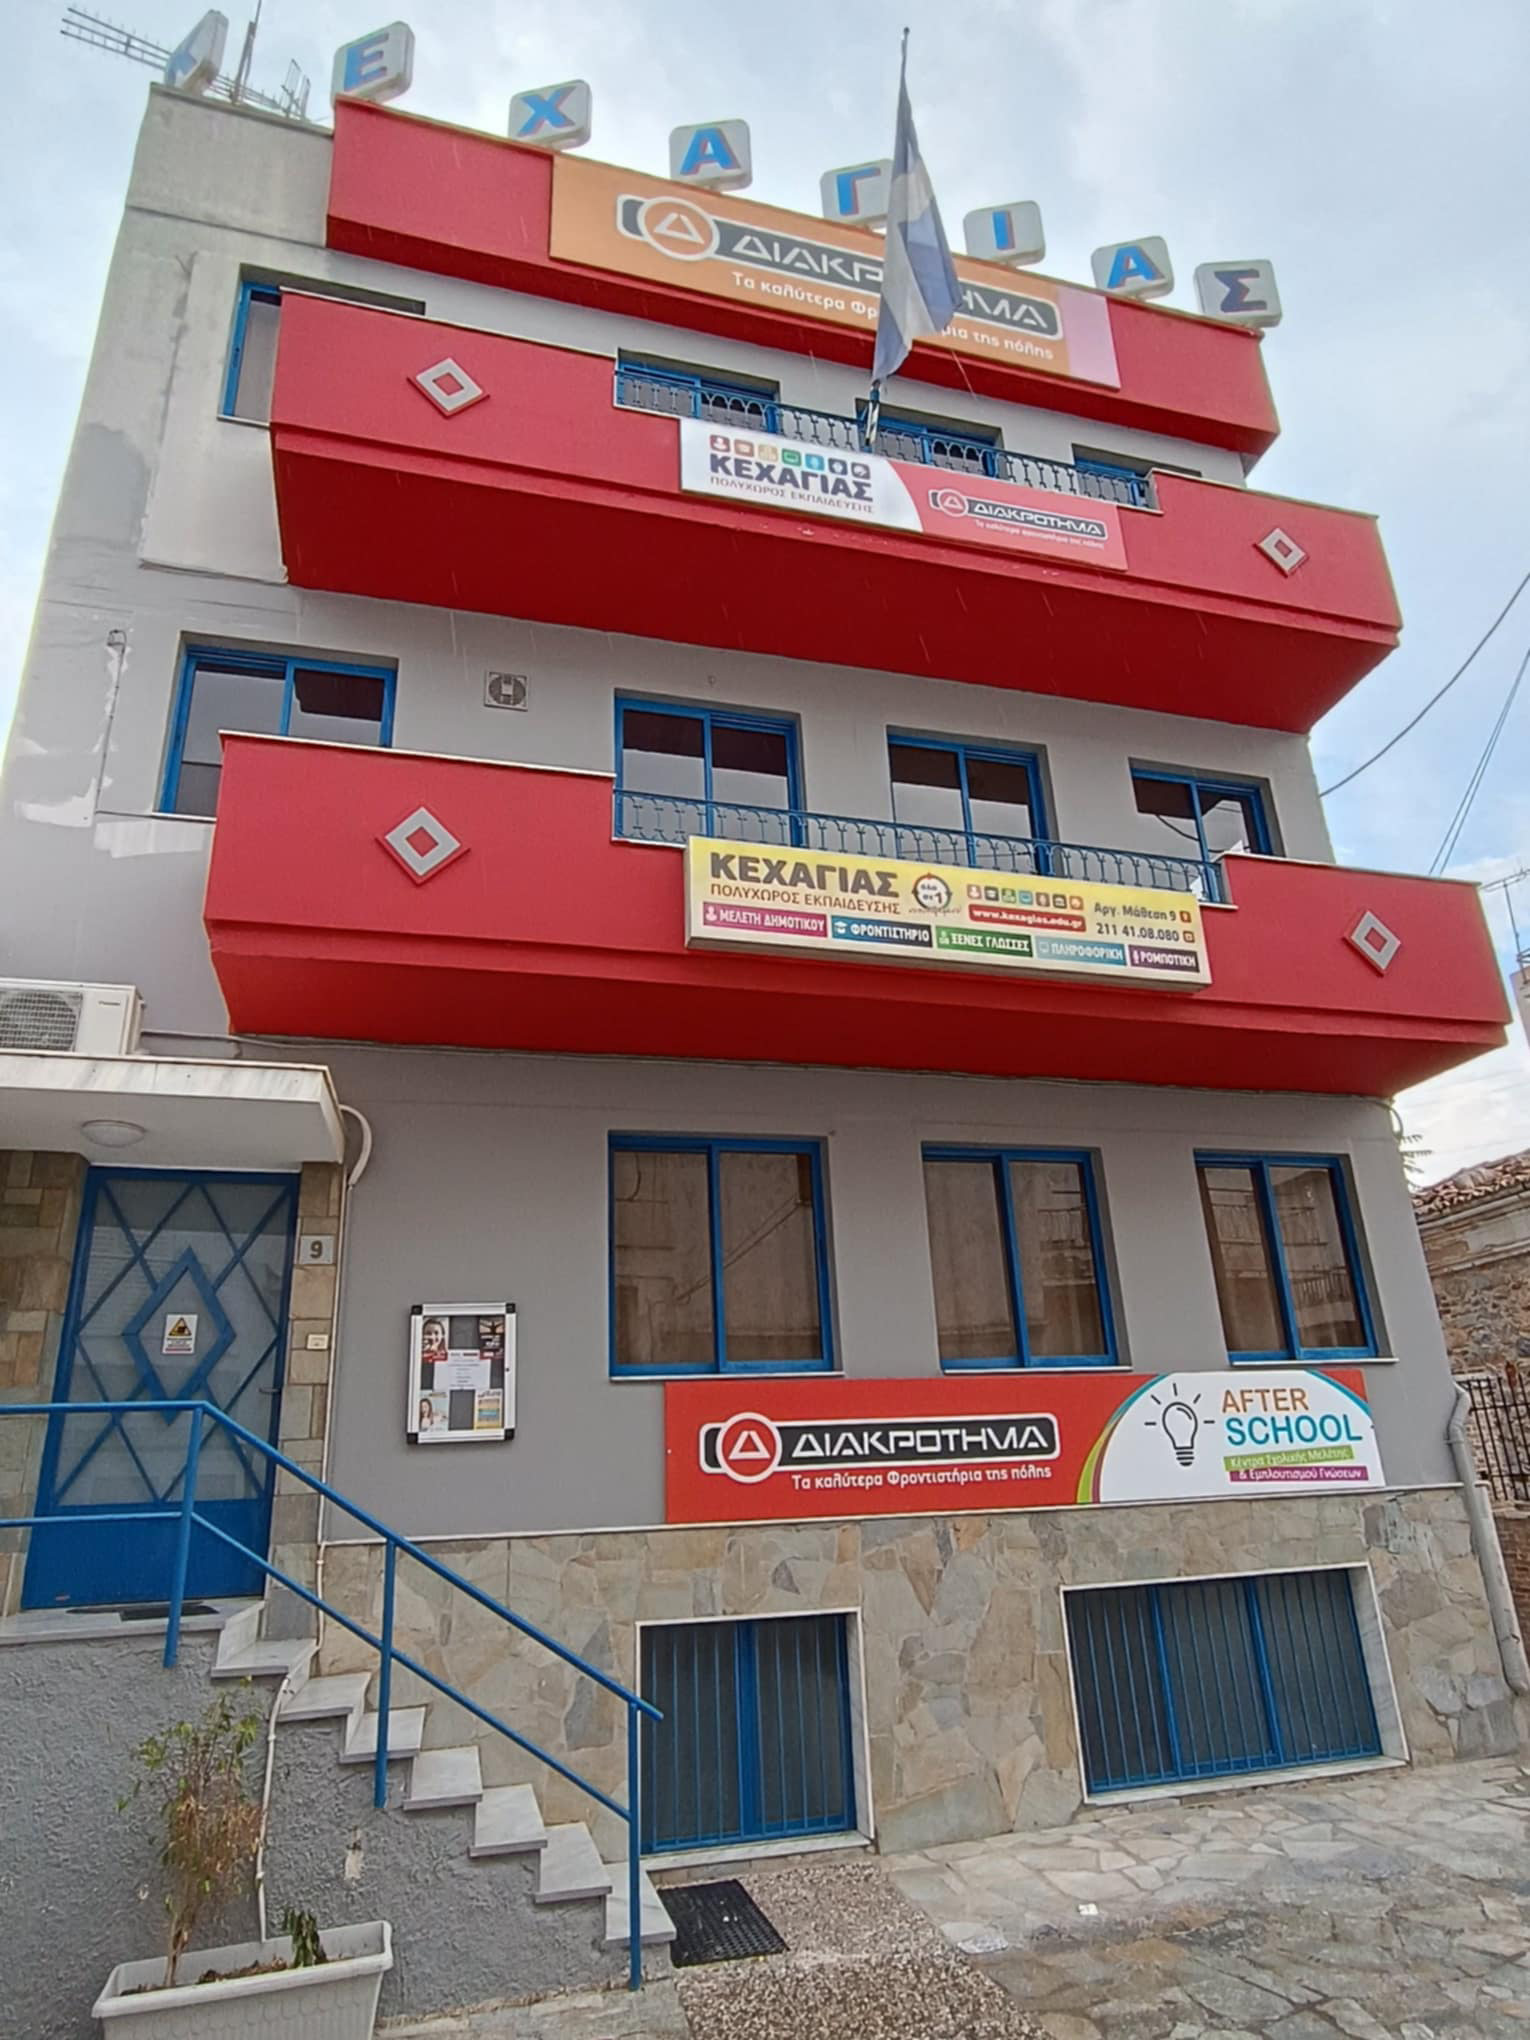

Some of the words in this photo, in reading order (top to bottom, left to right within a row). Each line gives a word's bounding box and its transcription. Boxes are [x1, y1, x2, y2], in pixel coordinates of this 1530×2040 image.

[732, 271, 756, 290] Τα
[761, 280, 846, 312] καλύτερα
[709, 453, 874, 503] ΚΕΧΑΓΙΑΣ
[710, 476, 786, 498] ΠΟΛΥΧΩΡΟΣ
[974, 504, 1102, 536] ΔΙΑΚΡΟΤΗΜΑ
[710, 851, 900, 898] ΚΕΧΑΓΙΑΣ
[710, 883, 801, 905] ΠΟΛΥΧΩΡΟΣ
[804, 895, 901, 915] ΕΚΠΑΙΔΕΥΣΗΣ
[719, 908, 761, 925] ΜΕΛΕΤΗ
[764, 913, 825, 932] ΔΗΜΟΤΙΚΟΥ
[1169, 910, 1177, 921] 9
[850, 923, 930, 942] ΦΡΟΝΤΙΣΤΗΡΙΟ
[1097, 922, 1118, 936] 211
[1139, 949, 1196, 967] ΡΟΜΠΟΤΙΚΗ
[309, 1240, 323, 1259] 9
[1222, 1388, 1309, 1413] AFTER
[791, 1425, 1049, 1458] ΔΙΑΚΡΟΤΗΜΑ
[1225, 1414, 1363, 1446] SCHOOL
[792, 1474, 811, 1490] Τα
[815, 1472, 883, 1490] καλύτερα
[887, 1467, 983, 1489] Φροντιστήρια
[985, 1467, 1008, 1481] της
[1011, 1464, 1052, 1479] πόλης
